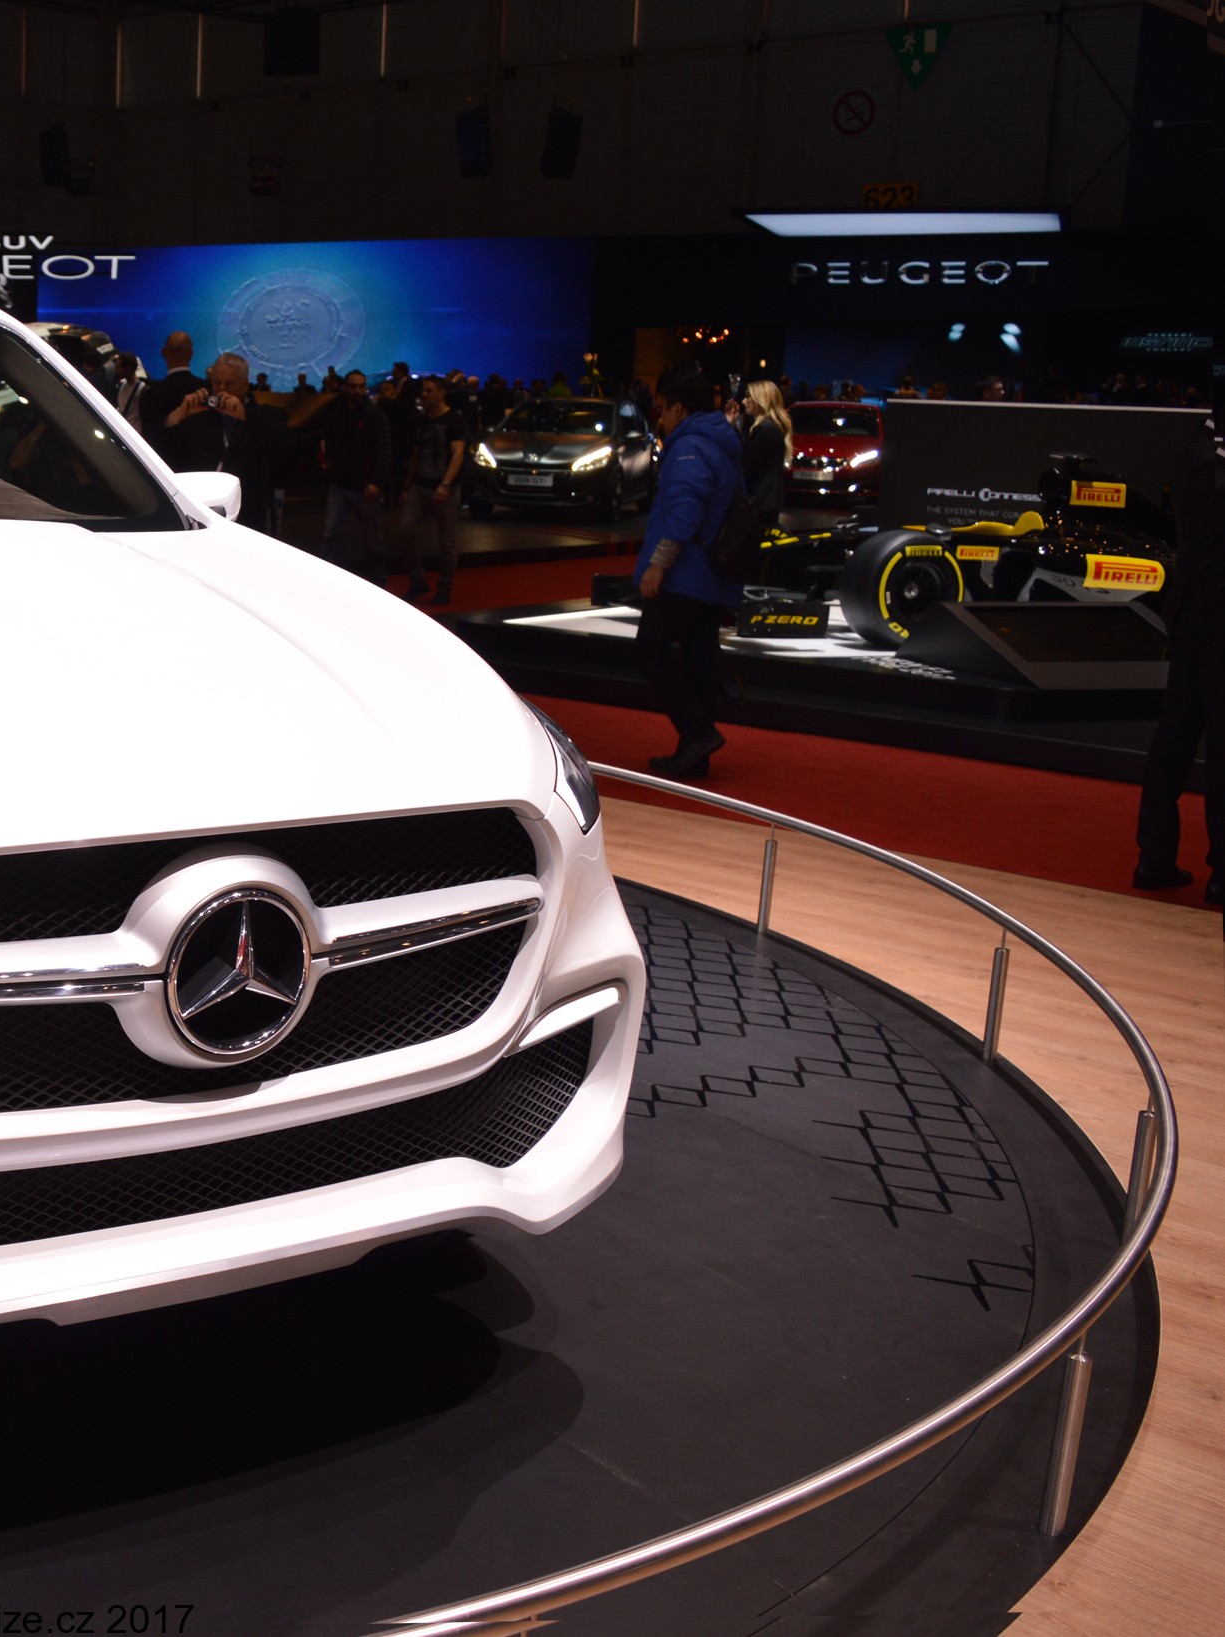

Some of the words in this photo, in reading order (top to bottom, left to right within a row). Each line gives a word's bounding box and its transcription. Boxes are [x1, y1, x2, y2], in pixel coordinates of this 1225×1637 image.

[864, 185, 915, 208] 623
[790, 260, 1050, 286] PEUGEOT
[927, 487, 975, 498] PIRELLI
[1076, 486, 1121, 503] PIRELLI
[944, 506, 975, 516] SYSTEM
[959, 548, 996, 558] PIRELLI
[1093, 561, 1158, 585] PIRELLI
[750, 615, 762, 625] P
[764, 615, 819, 626] ZERO
